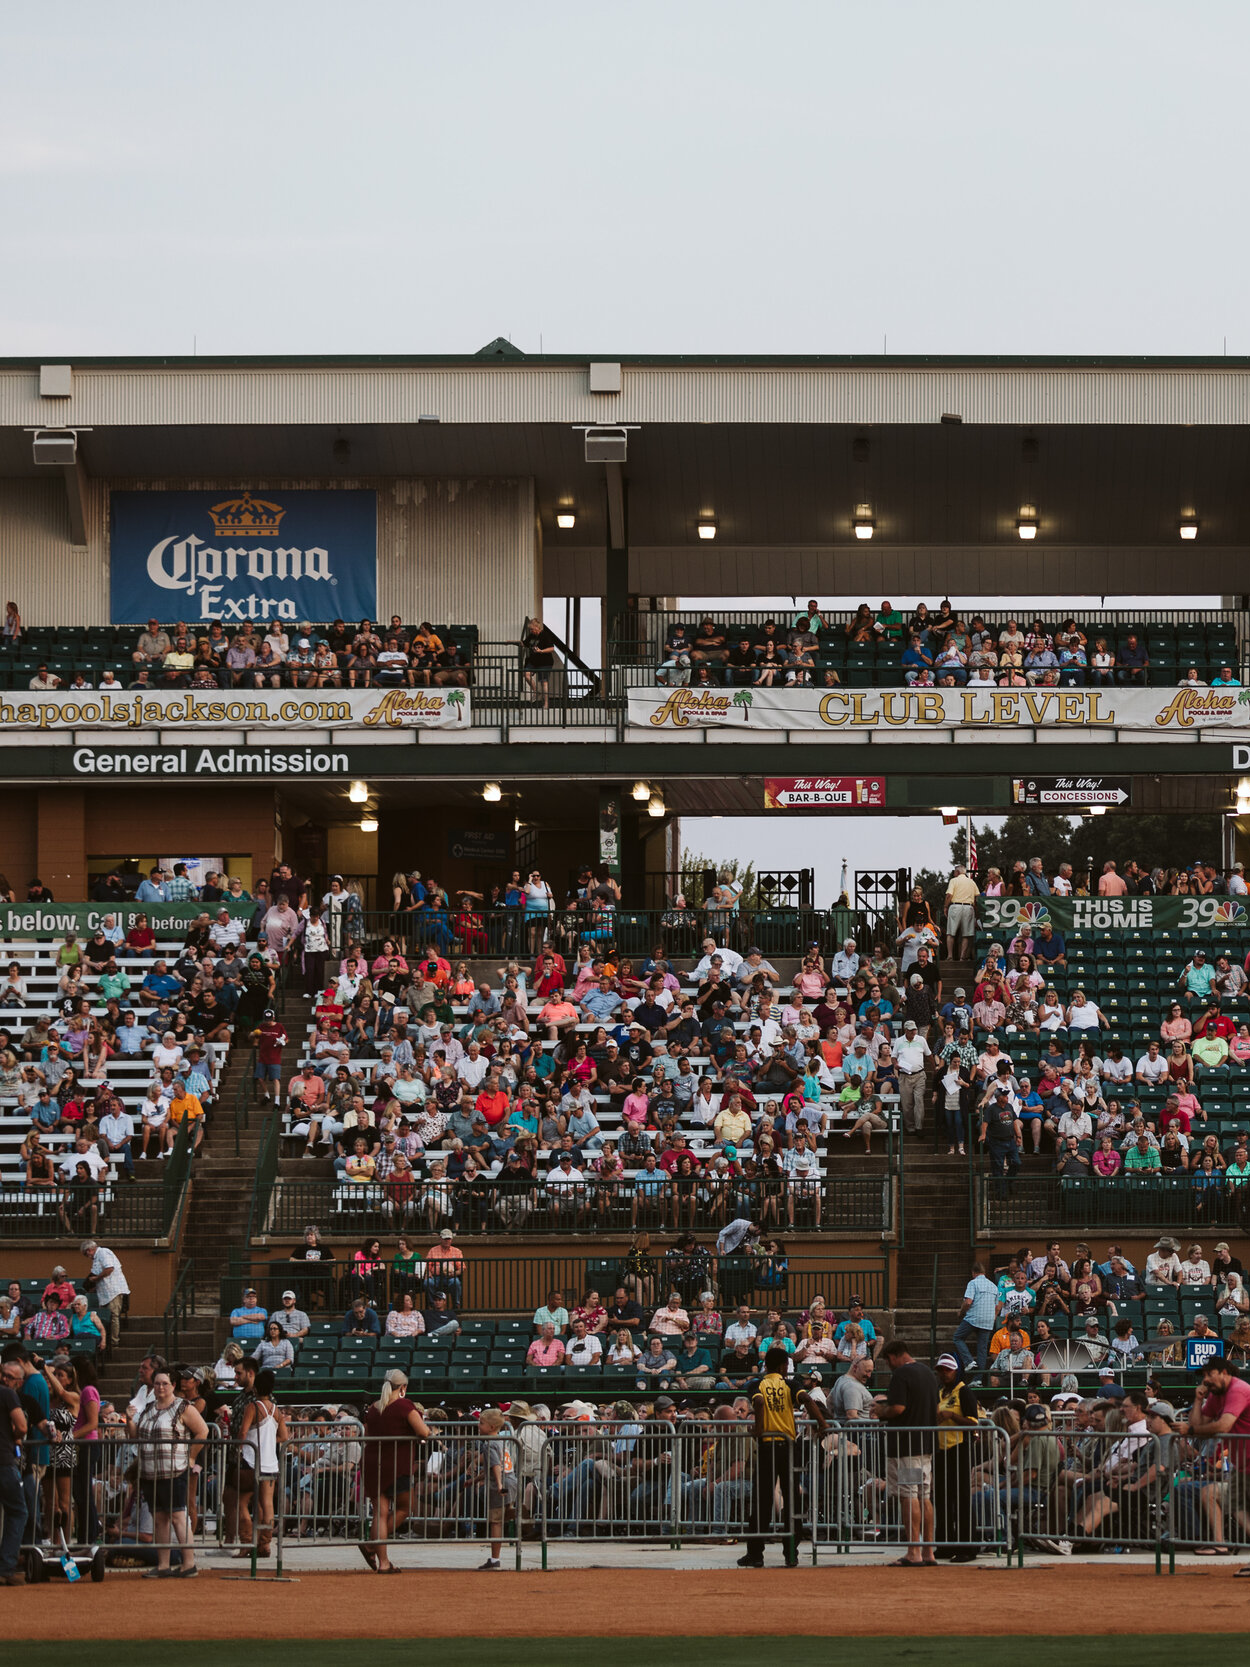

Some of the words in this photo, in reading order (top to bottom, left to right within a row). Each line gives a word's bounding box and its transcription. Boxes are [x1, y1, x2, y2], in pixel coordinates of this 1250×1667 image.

[146, 533, 333, 596] Corona
[199, 585, 298, 620] Extra
[363, 690, 446, 726] Aloha
[650, 689, 731, 726] Aloha
[818, 692, 946, 725] CLUB
[961, 692, 1114, 724] LEVEL
[1155, 689, 1236, 727] Aloha
[73, 749, 187, 773] General
[195, 749, 349, 773] Admission
[793, 779, 813, 790] This
[816, 779, 842, 792] Way!
[1055, 778, 1073, 789] This
[1076, 778, 1103, 791] Way!
[788, 793, 847, 803] BAR-B-QUE
[1044, 792, 1118, 801] CONCESSIONS
[982, 899, 1021, 928] 39
[1072, 900, 1124, 912] THIS
[1131, 900, 1153, 912] IS
[1177, 898, 1220, 928] 39
[8, 910, 80, 931] below.
[151, 916, 193, 930] befor
[1073, 913, 1153, 928] HOME
[1194, 1343, 1217, 1355] BUD
[1190, 1355, 1210, 1366] LIG
